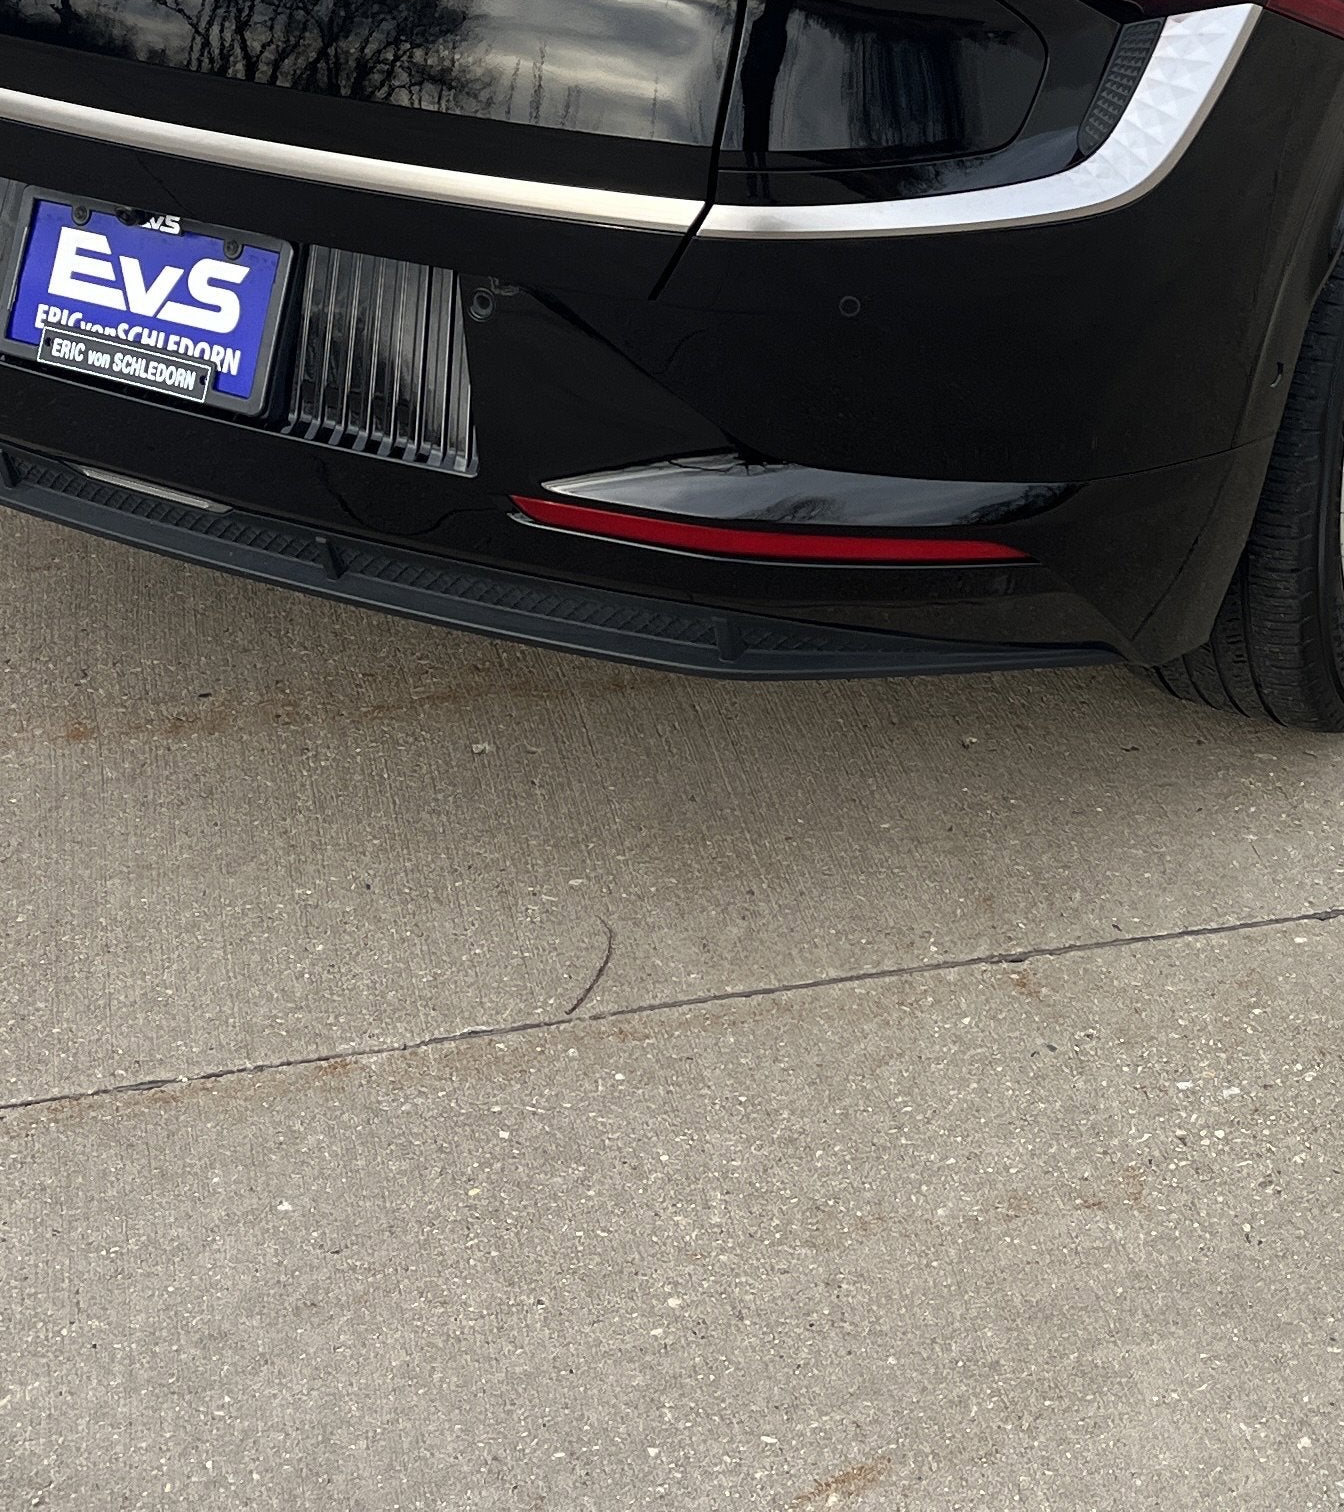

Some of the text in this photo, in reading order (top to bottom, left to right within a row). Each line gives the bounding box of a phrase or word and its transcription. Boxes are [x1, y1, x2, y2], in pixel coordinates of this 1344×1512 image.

[51, 338, 197, 391] ERIC von SCHLEDORN
